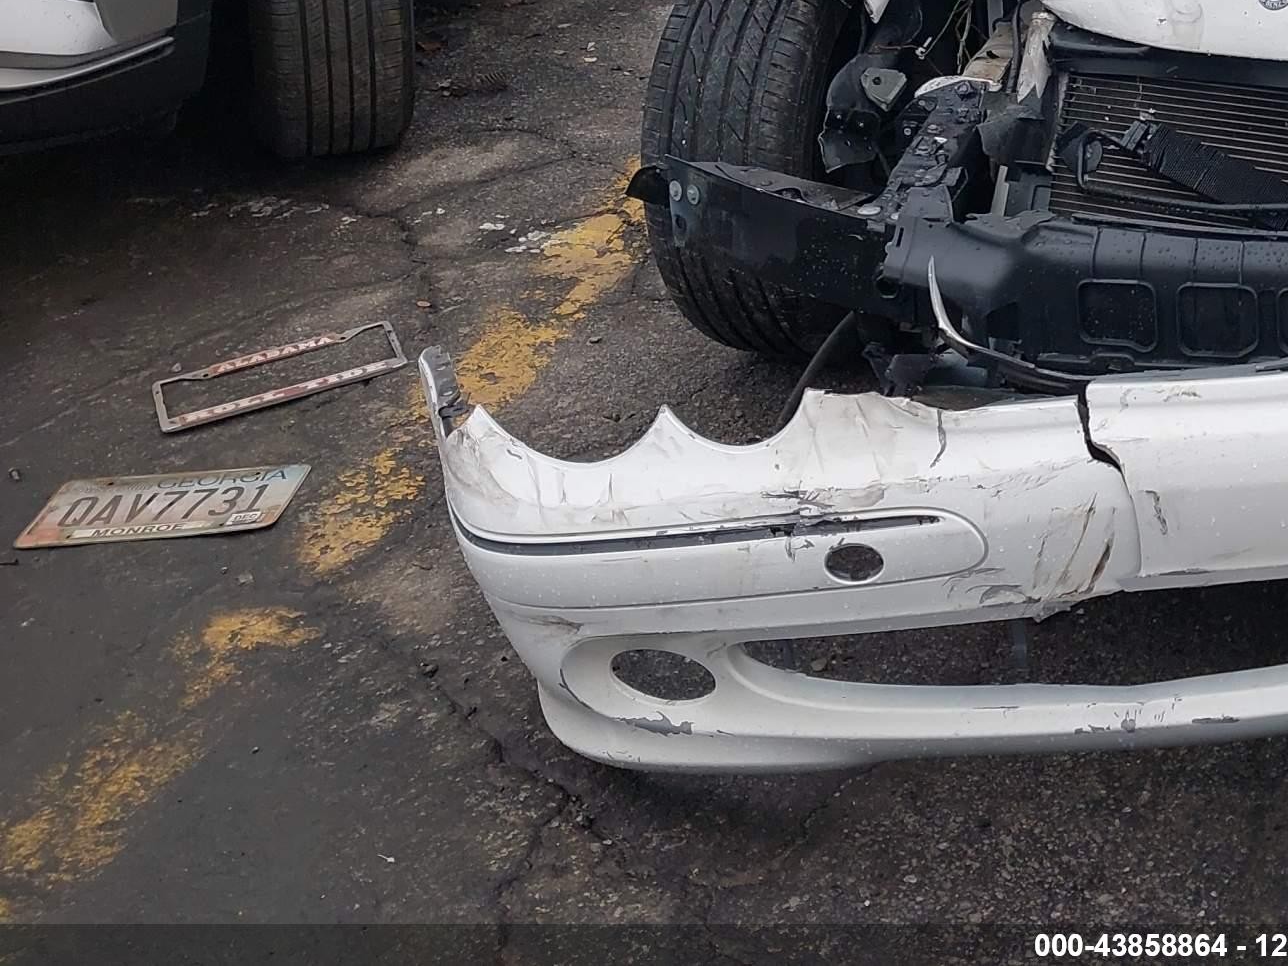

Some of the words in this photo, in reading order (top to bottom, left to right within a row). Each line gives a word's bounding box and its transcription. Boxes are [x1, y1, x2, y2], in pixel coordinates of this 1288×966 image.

[157, 469, 288, 489] GEORGIA
[57, 484, 271, 527] QAV7731
[91, 523, 186, 537] MONROE
